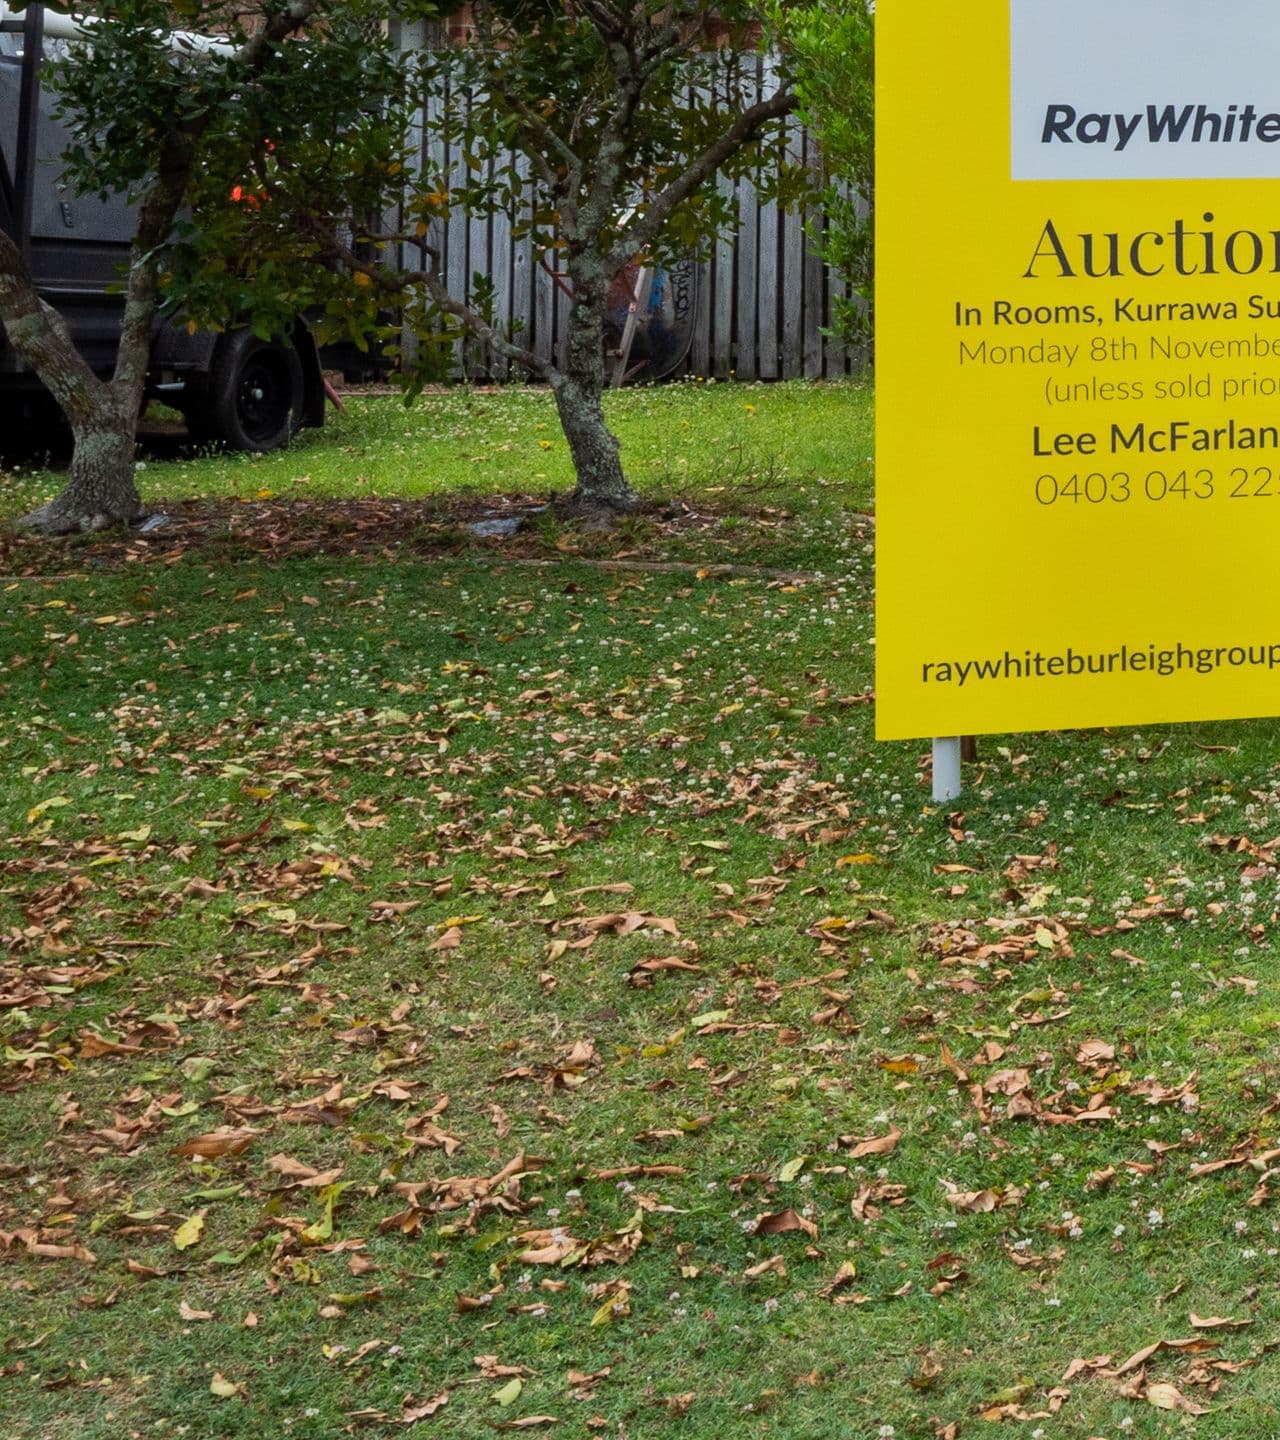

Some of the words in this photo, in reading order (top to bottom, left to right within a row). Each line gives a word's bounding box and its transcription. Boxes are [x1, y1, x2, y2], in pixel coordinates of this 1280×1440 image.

[955, 301, 982, 327] In
[993, 300, 1104, 327] Rooms,
[1114, 297, 1238, 323] Kurrawa
[959, 337, 1079, 368] Monday
[1090, 335, 1137, 362] 8th
[1045, 375, 1144, 406] (unless
[1154, 372, 1211, 399] sold
[1033, 425, 1097, 457] Lee
[1035, 471, 1131, 506] 0403
[1144, 468, 1214, 502] 043
